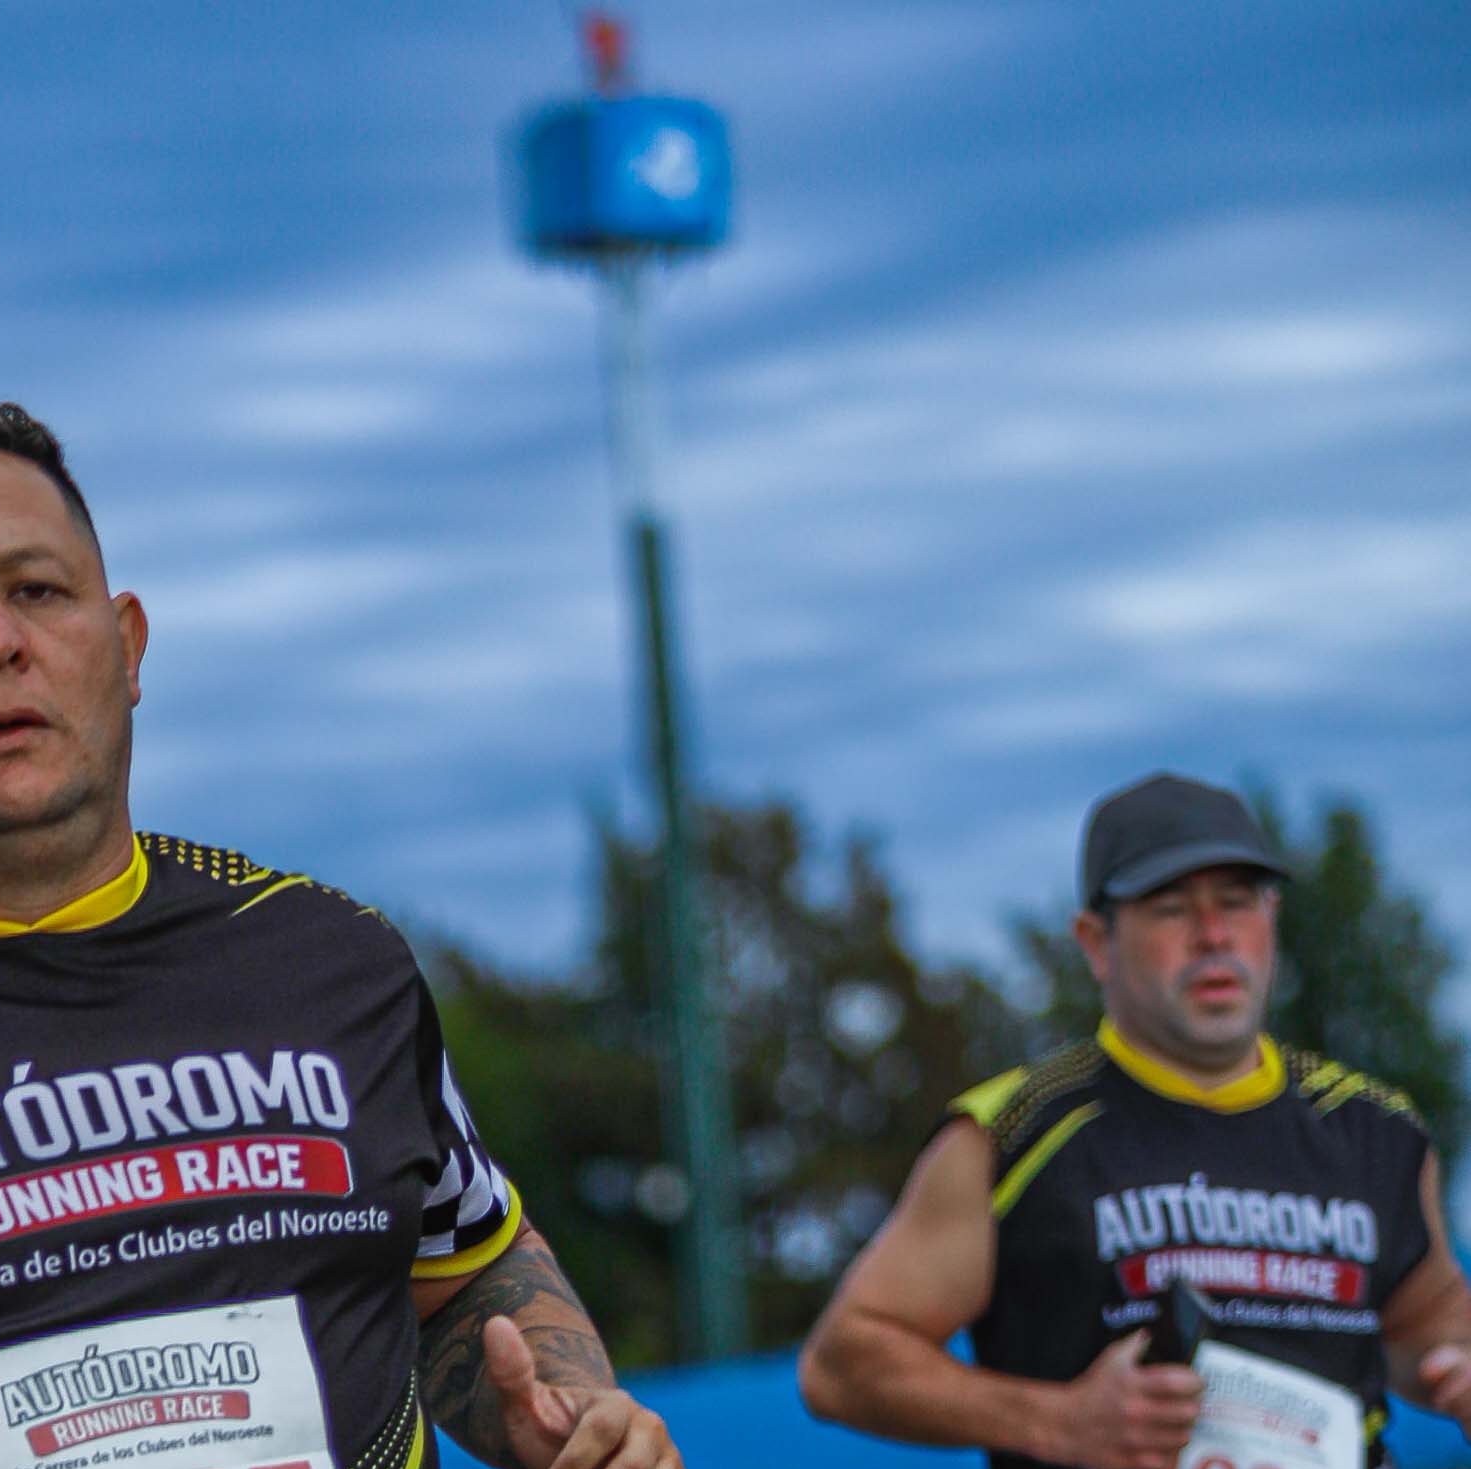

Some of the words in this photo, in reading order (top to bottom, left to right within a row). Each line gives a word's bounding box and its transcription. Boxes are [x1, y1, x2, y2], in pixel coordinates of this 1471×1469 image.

[175, 1144, 305, 1193] RACE
[24, 1250, 62, 1280] de
[68, 1243, 112, 1272] los
[118, 1225, 220, 1262] Clubes
[227, 1212, 273, 1244] del
[280, 1206, 390, 1238] Noroeste
[1094, 1171, 1378, 1263] AUTÓDROMO
[0, 1341, 260, 1428] AUTÓDROMO
[51, 1400, 158, 1448] RUNNING
[162, 1394, 225, 1421] RACE
[91, 1449, 110, 1465] de
[112, 1445, 135, 1461] los
[136, 1436, 186, 1455] Clubes
[188, 1432, 210, 1448] del
[212, 1424, 275, 1443] Noroeste
